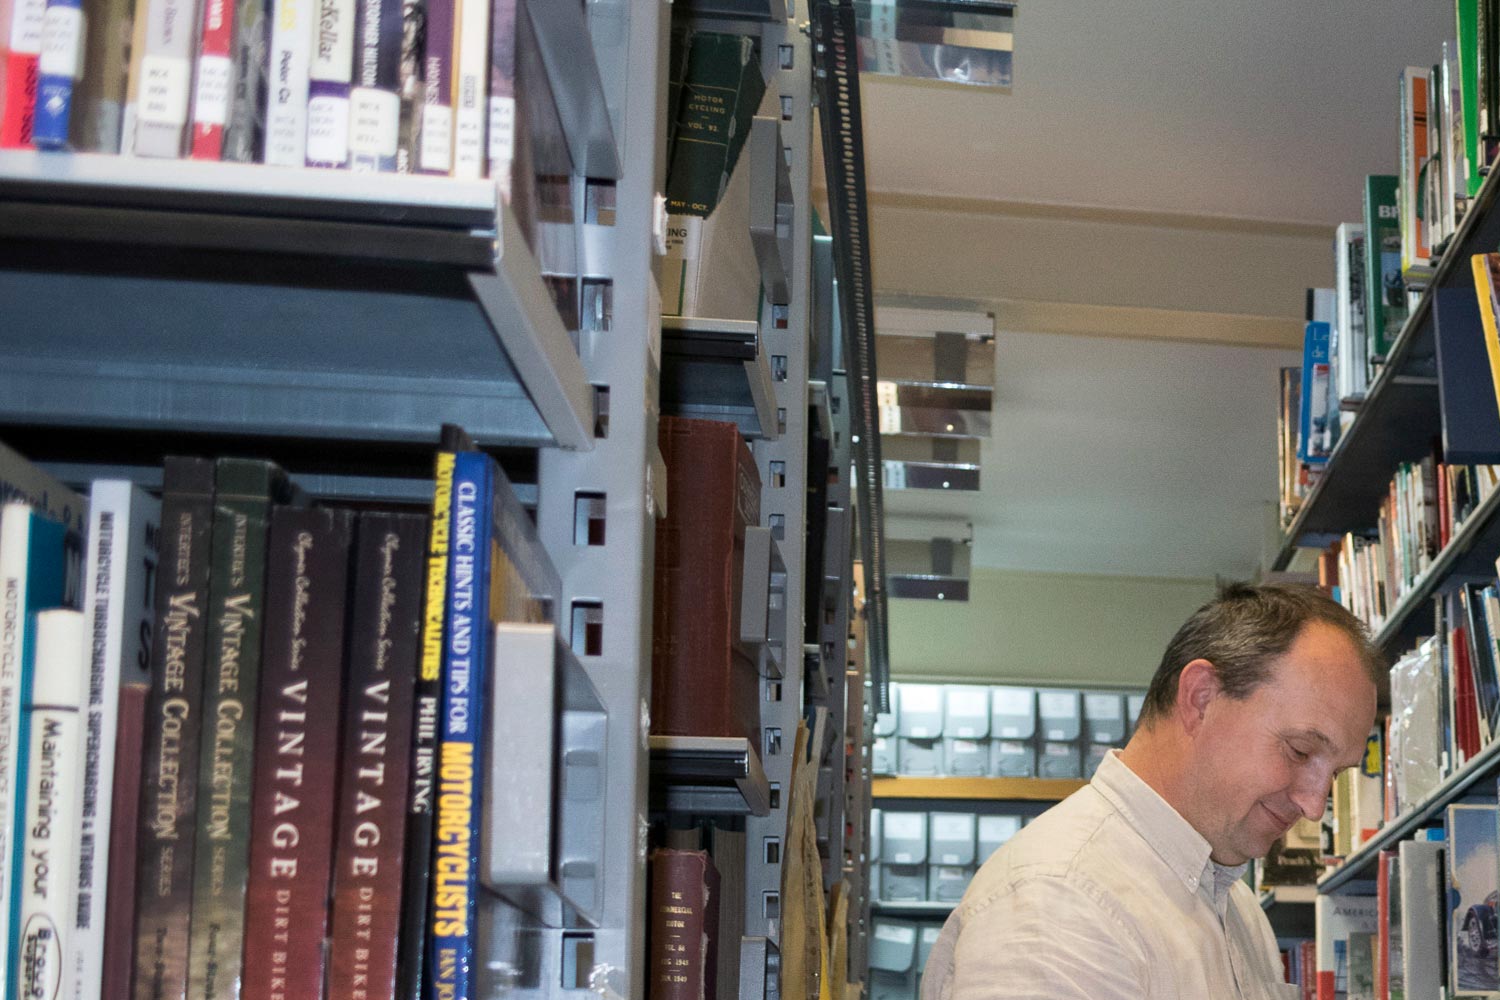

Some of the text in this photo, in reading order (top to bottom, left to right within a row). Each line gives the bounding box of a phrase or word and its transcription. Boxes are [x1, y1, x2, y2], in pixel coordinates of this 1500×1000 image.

[426, 57, 443, 105] HAYNES
[688, 103, 726, 116] CYCLING
[693, 94, 725, 105] MOTOR
[448, 482, 477, 734] CLASSIC HINTS AND TIPS FOR
[268, 681, 308, 878] VINTAGE
[351, 680, 391, 877] VINTAGE
[411, 696, 437, 814] PHIL IRVING
[32, 717, 63, 898] Maintaining your
[434, 742, 473, 937] MOTORCYCLISTS
[273, 890, 291, 945] DIRT
[356, 887, 374, 944] DIRT
[438, 949, 458, 978] IAN
